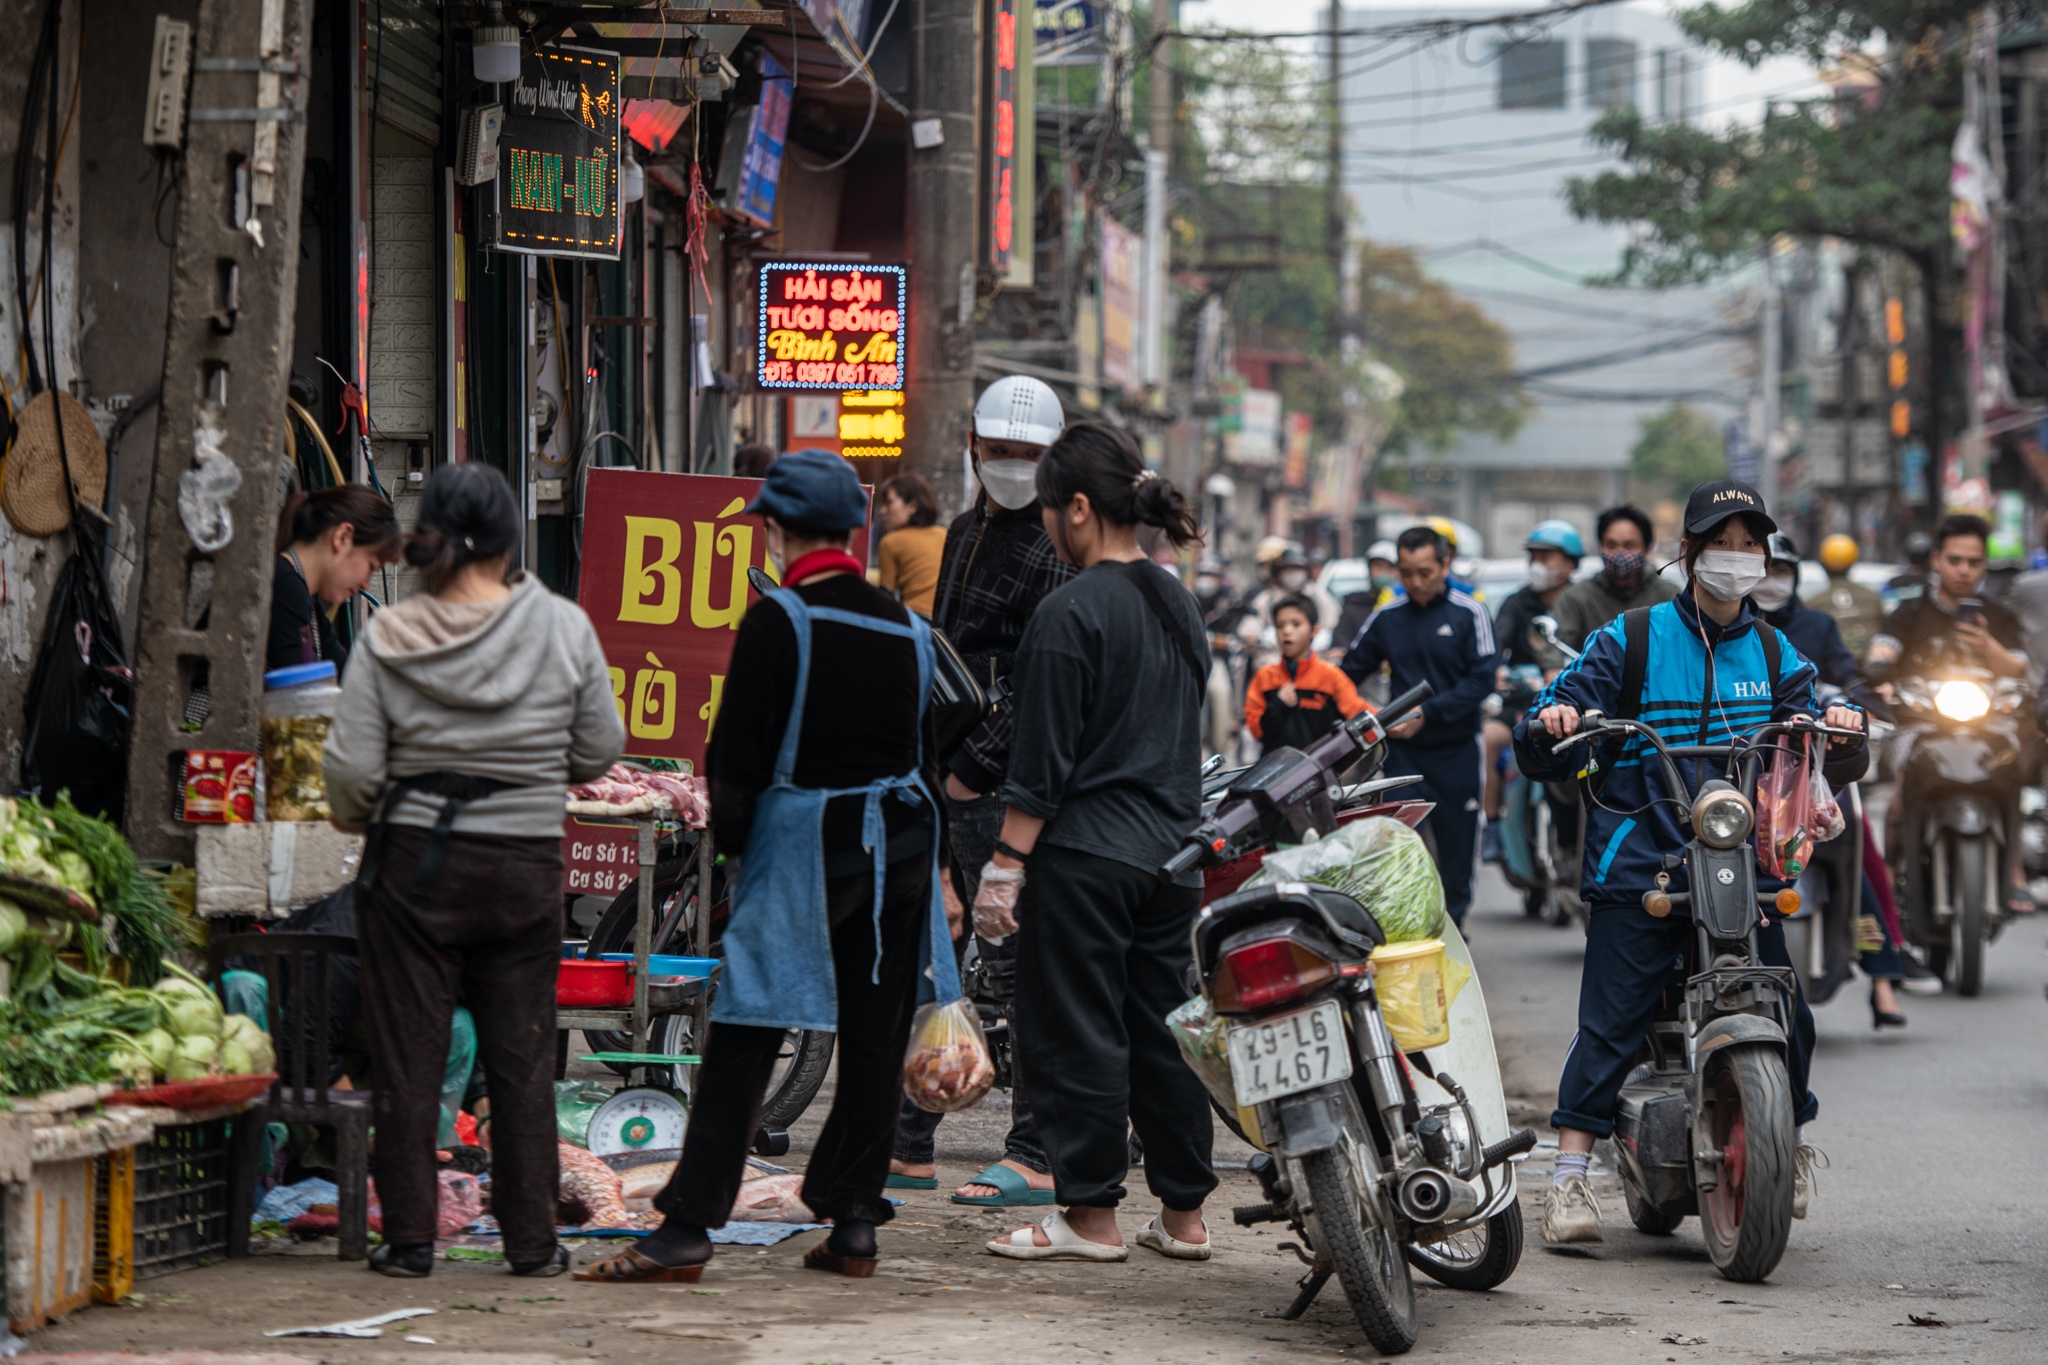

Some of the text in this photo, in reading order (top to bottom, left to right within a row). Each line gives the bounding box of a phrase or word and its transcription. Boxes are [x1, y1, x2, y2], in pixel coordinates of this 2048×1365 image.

[560, 80, 577, 111] Hair
[785, 269, 882, 302] HẢI SẢN
[767, 301, 898, 332] TƯƠI SỐNG
[767, 329, 897, 364] Bình An
[763, 361, 793, 382] ĐT:
[796, 362, 836, 383] 0397
[867, 364, 898, 385] 799
[1713, 490, 1754, 505] ALWAYS
[571, 842, 635, 864] Cơ Sở 1:
[569, 869, 590, 888] Cơ
[593, 870, 614, 891] Sở
[1245, 1011, 1328, 1061] 29-L6
[1253, 1045, 1329, 1095] 4467
